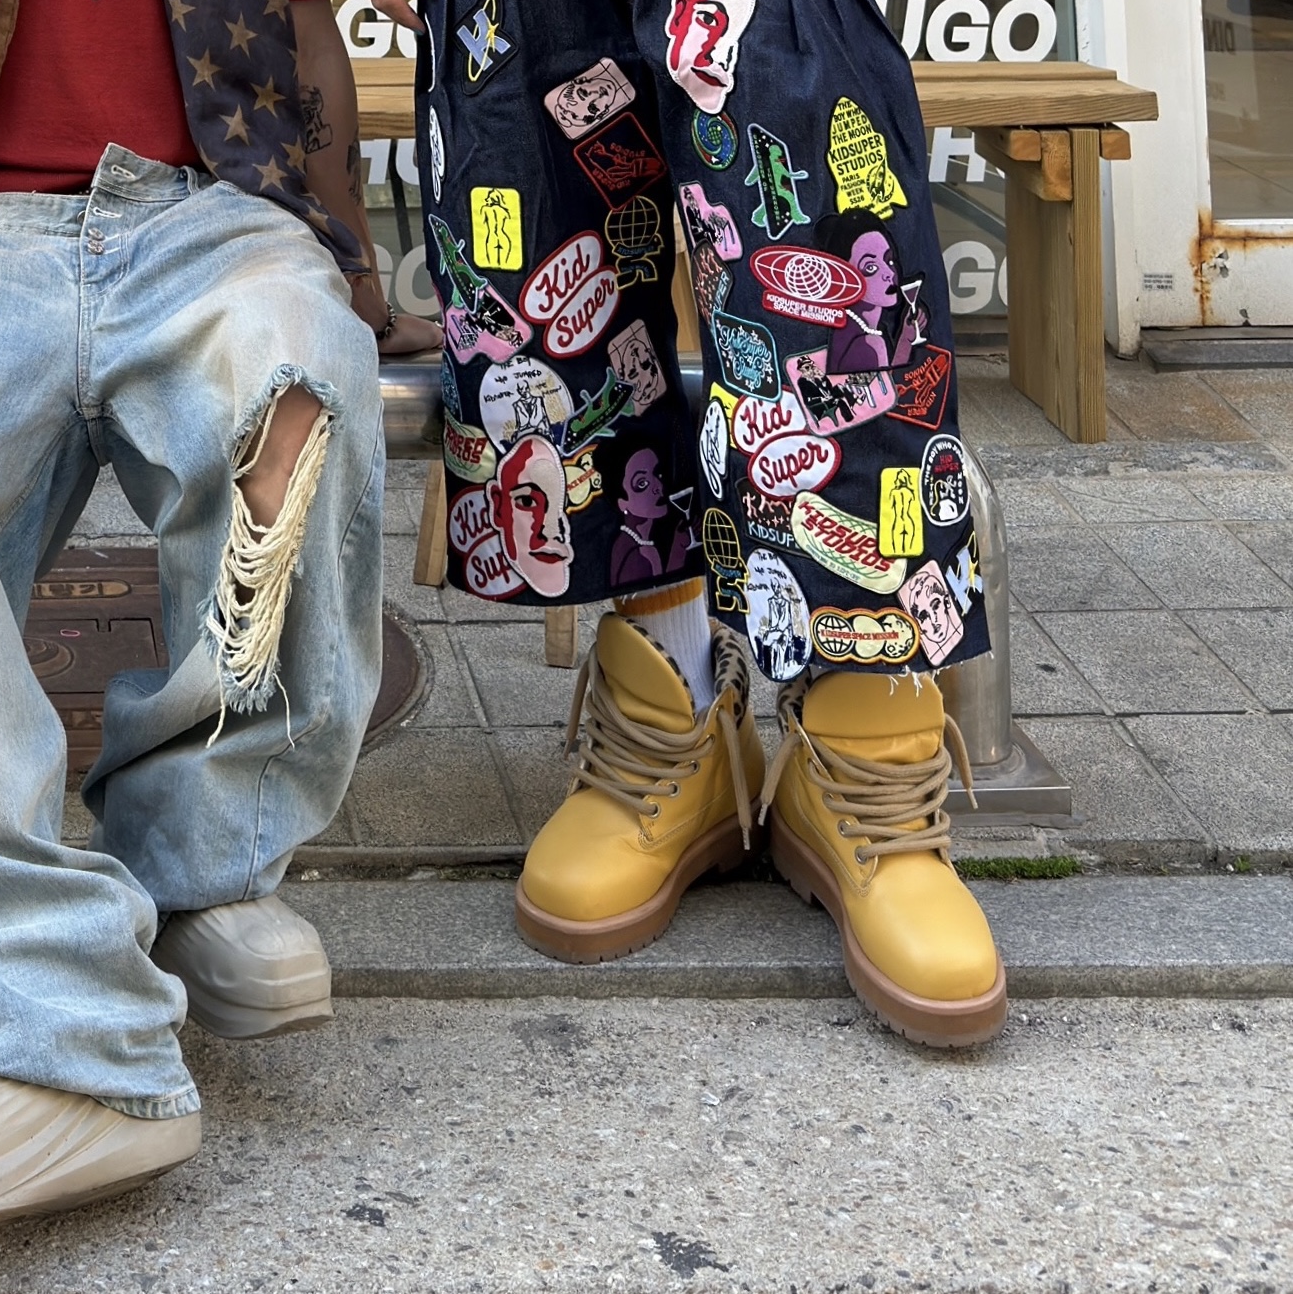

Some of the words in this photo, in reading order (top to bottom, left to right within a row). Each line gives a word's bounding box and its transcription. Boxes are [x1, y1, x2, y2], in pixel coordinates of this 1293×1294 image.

[834, 111, 845, 122] BOY
[847, 107, 861, 118] WHO
[838, 101, 851, 111] THE
[832, 114, 867, 134] JUMPED
[832, 133, 848, 145] THE
[849, 125, 872, 140] MOON
[829, 134, 883, 163] KIDSUPER
[836, 149, 883, 175] STUDIOS
[840, 179, 866, 190] FASHION
[842, 173, 860, 183] PARIS
[847, 188, 864, 197] WEEK
[535, 243, 590, 312] Kid
[556, 278, 614, 347] Super
[767, 294, 806, 312] KIDSUPER
[808, 305, 843, 318] STUDIOS
[774, 302, 800, 316] SPACE
[801, 310, 835, 323] MISSION
[740, 399, 792, 446] Kid
[936, 441, 952, 451] WHO
[759, 441, 828, 490] Super
[801, 520, 895, 572] STUDIOS
[820, 629, 852, 640] KIDSUPER
[852, 632, 871, 640] SPACE
[872, 631, 899, 640] MISSION
